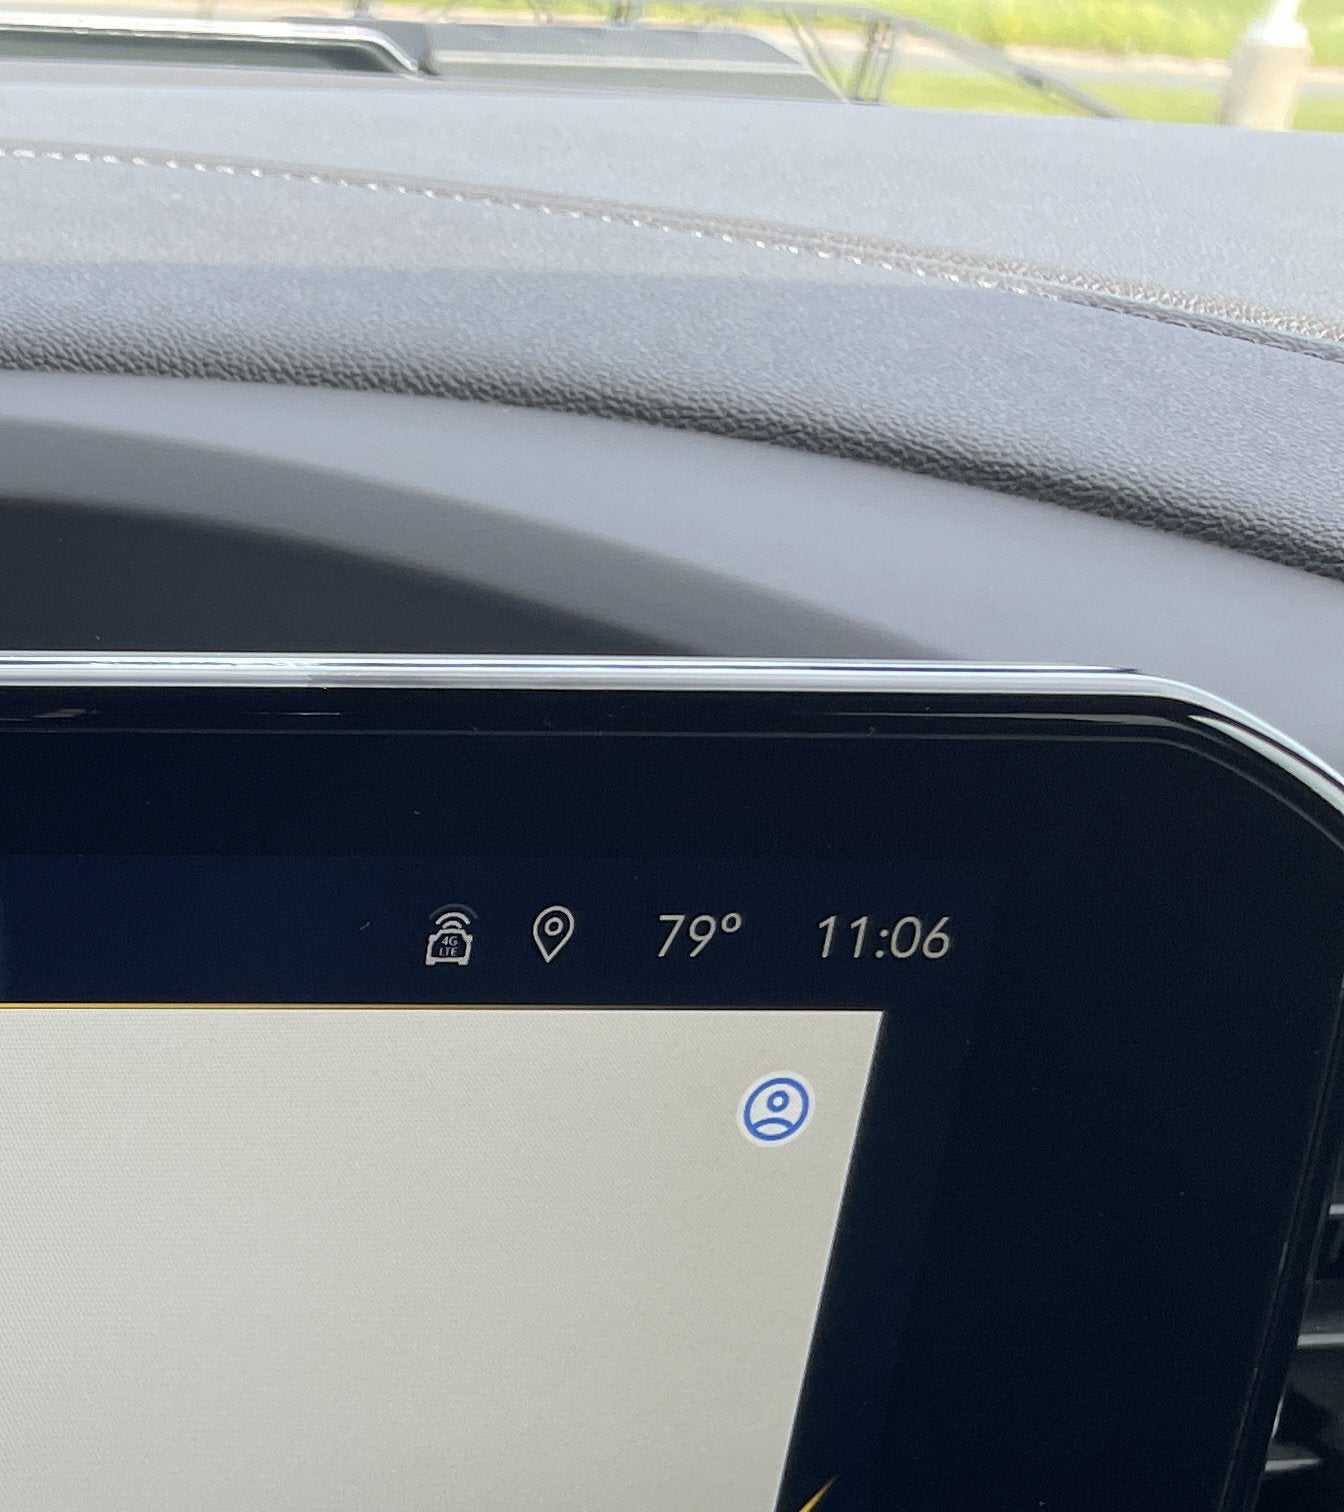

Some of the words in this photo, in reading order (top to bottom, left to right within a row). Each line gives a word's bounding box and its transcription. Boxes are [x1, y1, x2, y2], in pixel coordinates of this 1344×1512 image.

[440, 935, 459, 947] 4G
[817, 915, 952, 959] 11:06
[438, 946, 459, 958] LTE
